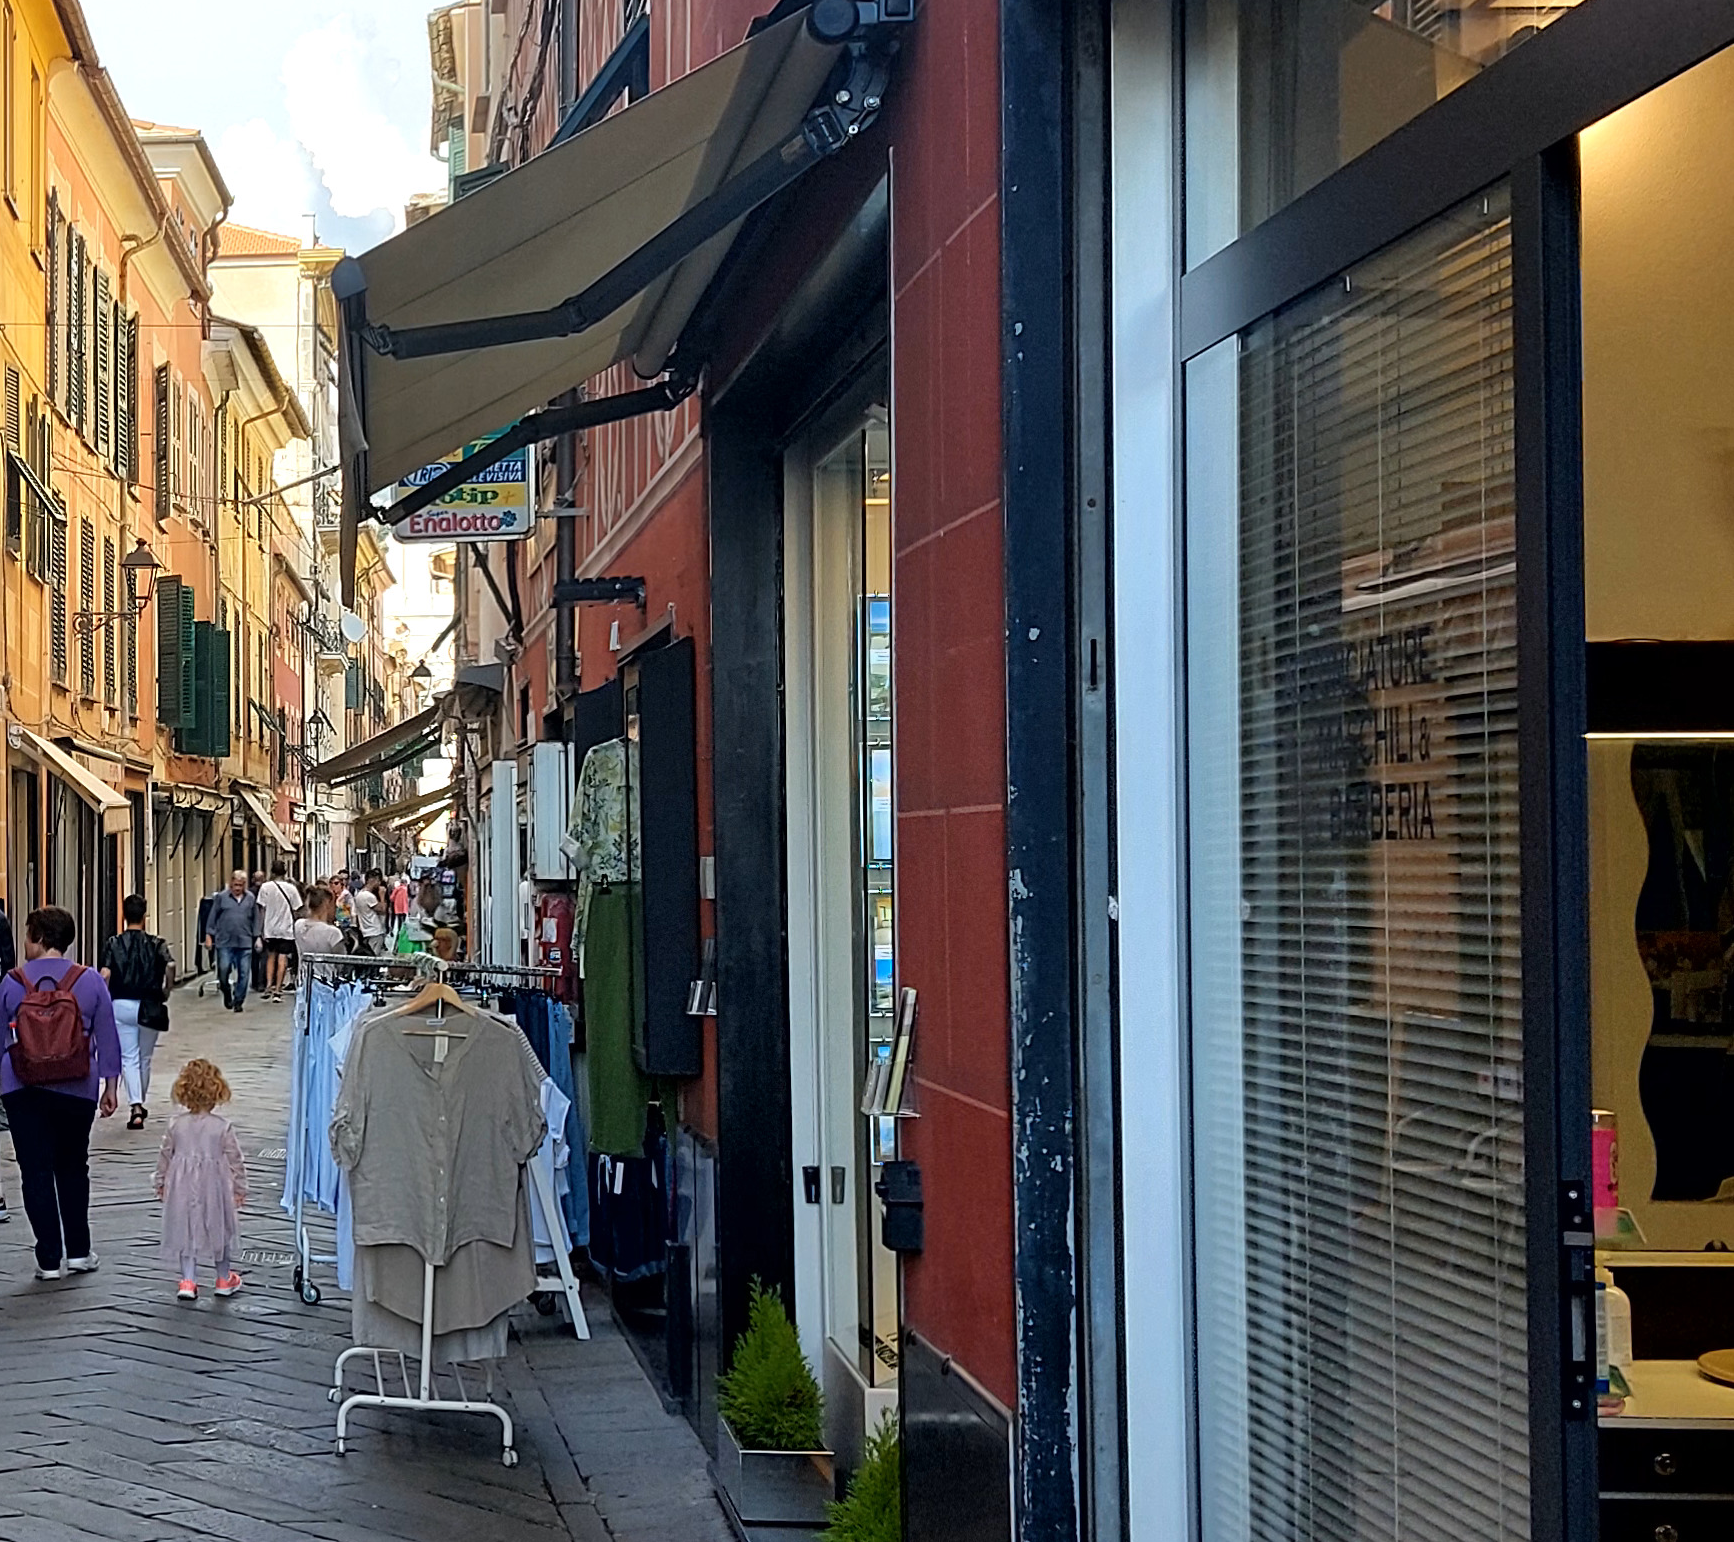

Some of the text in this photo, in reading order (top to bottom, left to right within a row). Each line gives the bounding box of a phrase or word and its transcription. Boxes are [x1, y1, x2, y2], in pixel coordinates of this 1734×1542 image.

[466, 471, 522, 482] LEVISIVA
[431, 487, 500, 506] otip
[410, 512, 502, 534] Enalotto
